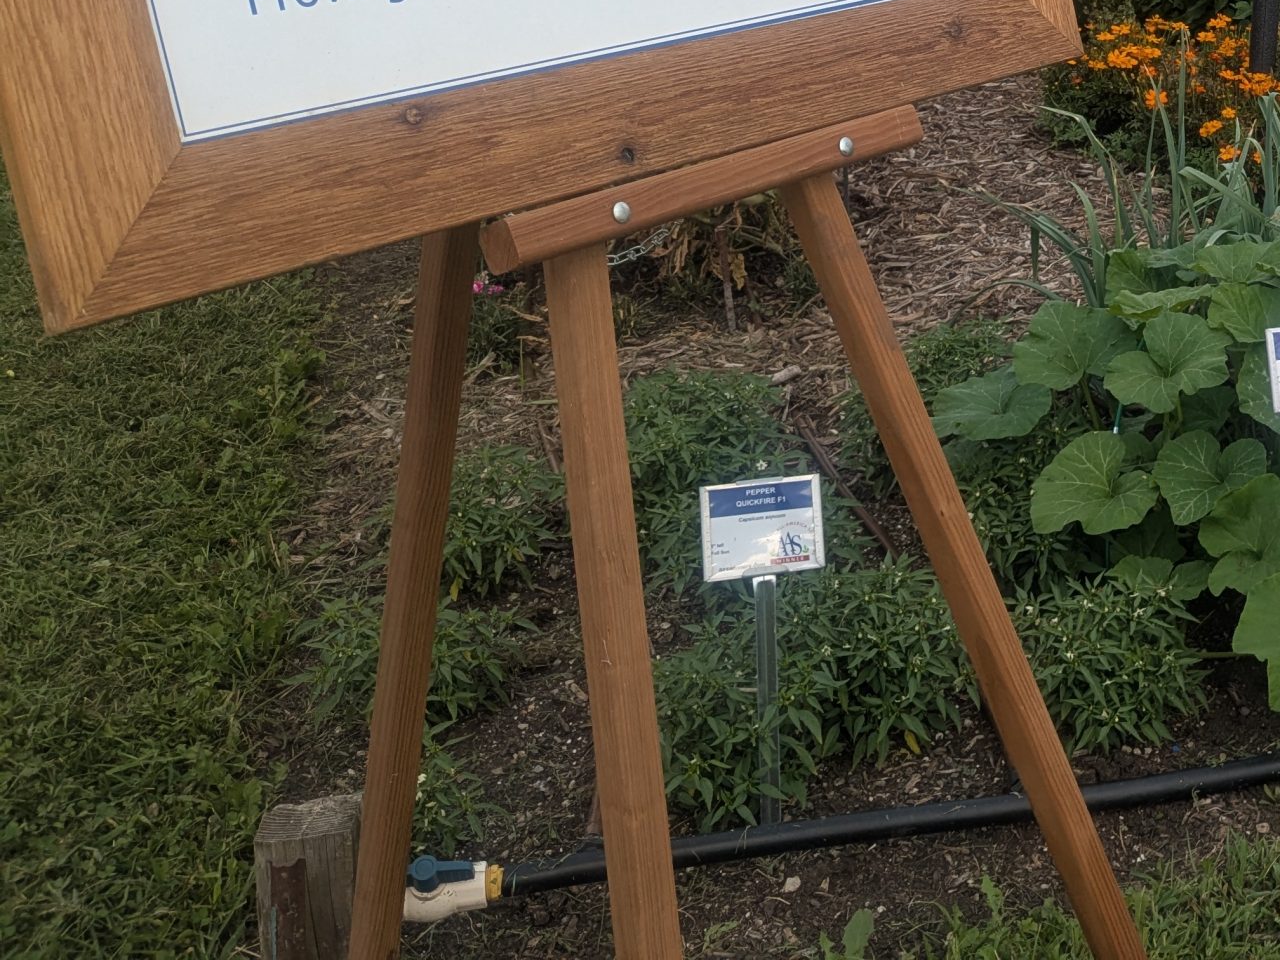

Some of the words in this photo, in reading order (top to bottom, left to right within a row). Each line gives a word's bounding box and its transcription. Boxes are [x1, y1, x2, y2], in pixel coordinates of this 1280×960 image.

[745, 487, 776, 496] PEPPER
[735, 497, 776, 508] QUICKFIRE
[777, 496, 787, 504] F1
[777, 531, 803, 557] AAS
